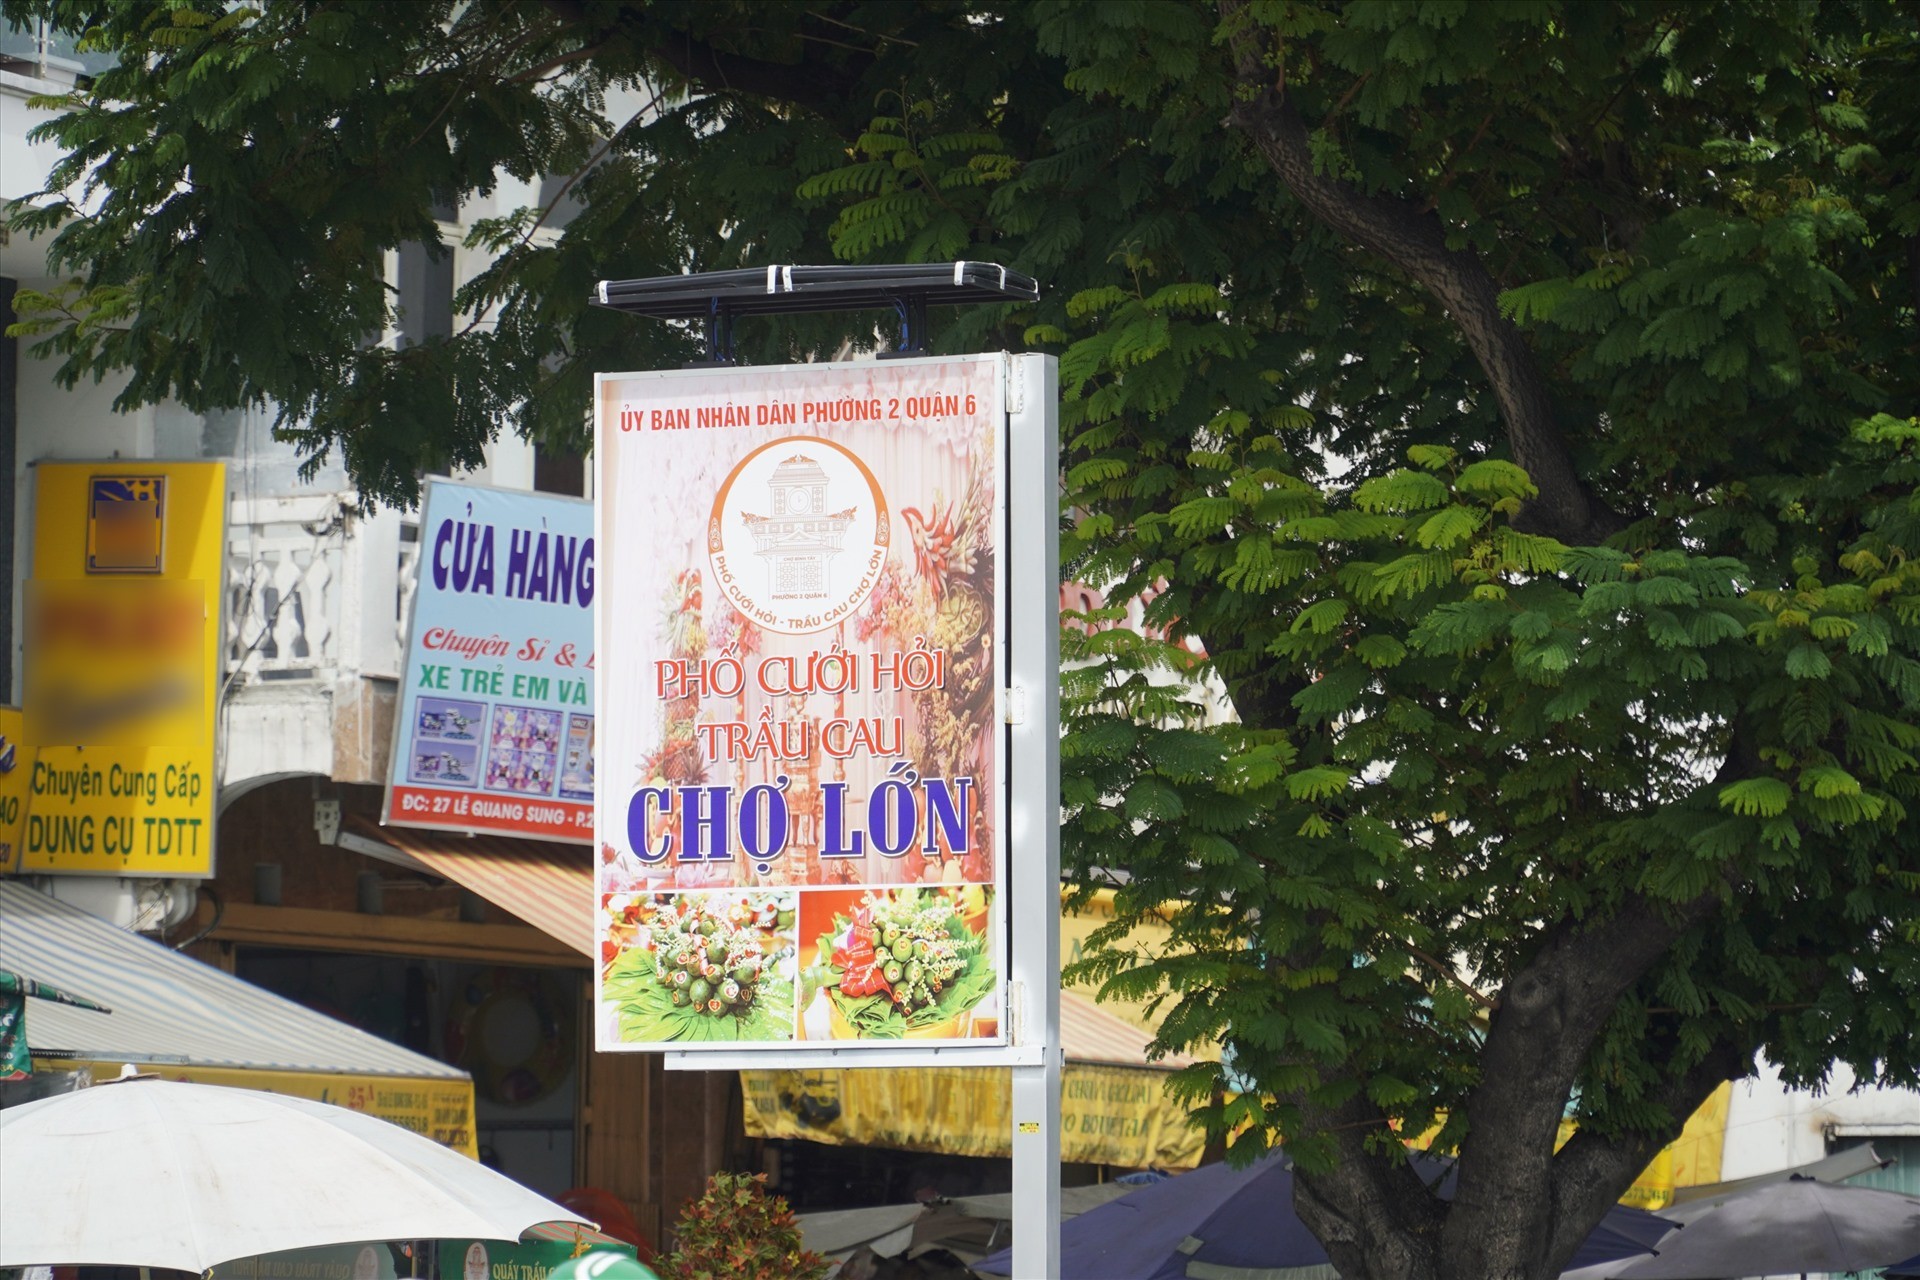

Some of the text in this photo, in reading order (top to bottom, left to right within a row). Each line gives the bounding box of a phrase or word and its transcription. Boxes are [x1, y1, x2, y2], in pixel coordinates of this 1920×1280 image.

[621, 391, 976, 432] ỦY BAN NHÂN DÂN PHƯỜNG 2 QUẬN 6
[433, 501, 594, 609] CỬA HÀNG
[715, 555, 736, 584] PHỐ
[729, 584, 755, 613] CƯỚI
[754, 608, 777, 625] HỎI
[824, 602, 848, 623] CAU
[848, 576, 871, 604] CHỢ
[866, 549, 882, 578] LỚN
[771, 592, 798, 600] PHƯỜNG
[422, 626, 511, 661] Chuyên
[517, 637, 551, 662] Sỉ
[554, 643, 576, 669] &
[654, 636, 945, 698] PHỐ CƯỚI HỎI
[418, 664, 587, 706] XE TRẺ EM VÀ
[697, 705, 903, 761] TRẦU CAU
[32, 761, 201, 807] Chuyên Cung Cấp
[402, 793, 429, 813] ĐC:
[433, 796, 451, 814] 27
[453, 795, 469, 816] LÊ
[471, 800, 523, 821] QUANG
[526, 805, 565, 826] SUNG
[627, 761, 973, 873] CHỢ LỚN
[28, 815, 95, 864] DỤNG
[102, 816, 135, 865] CỤ
[143, 817, 202, 856] TDTT
